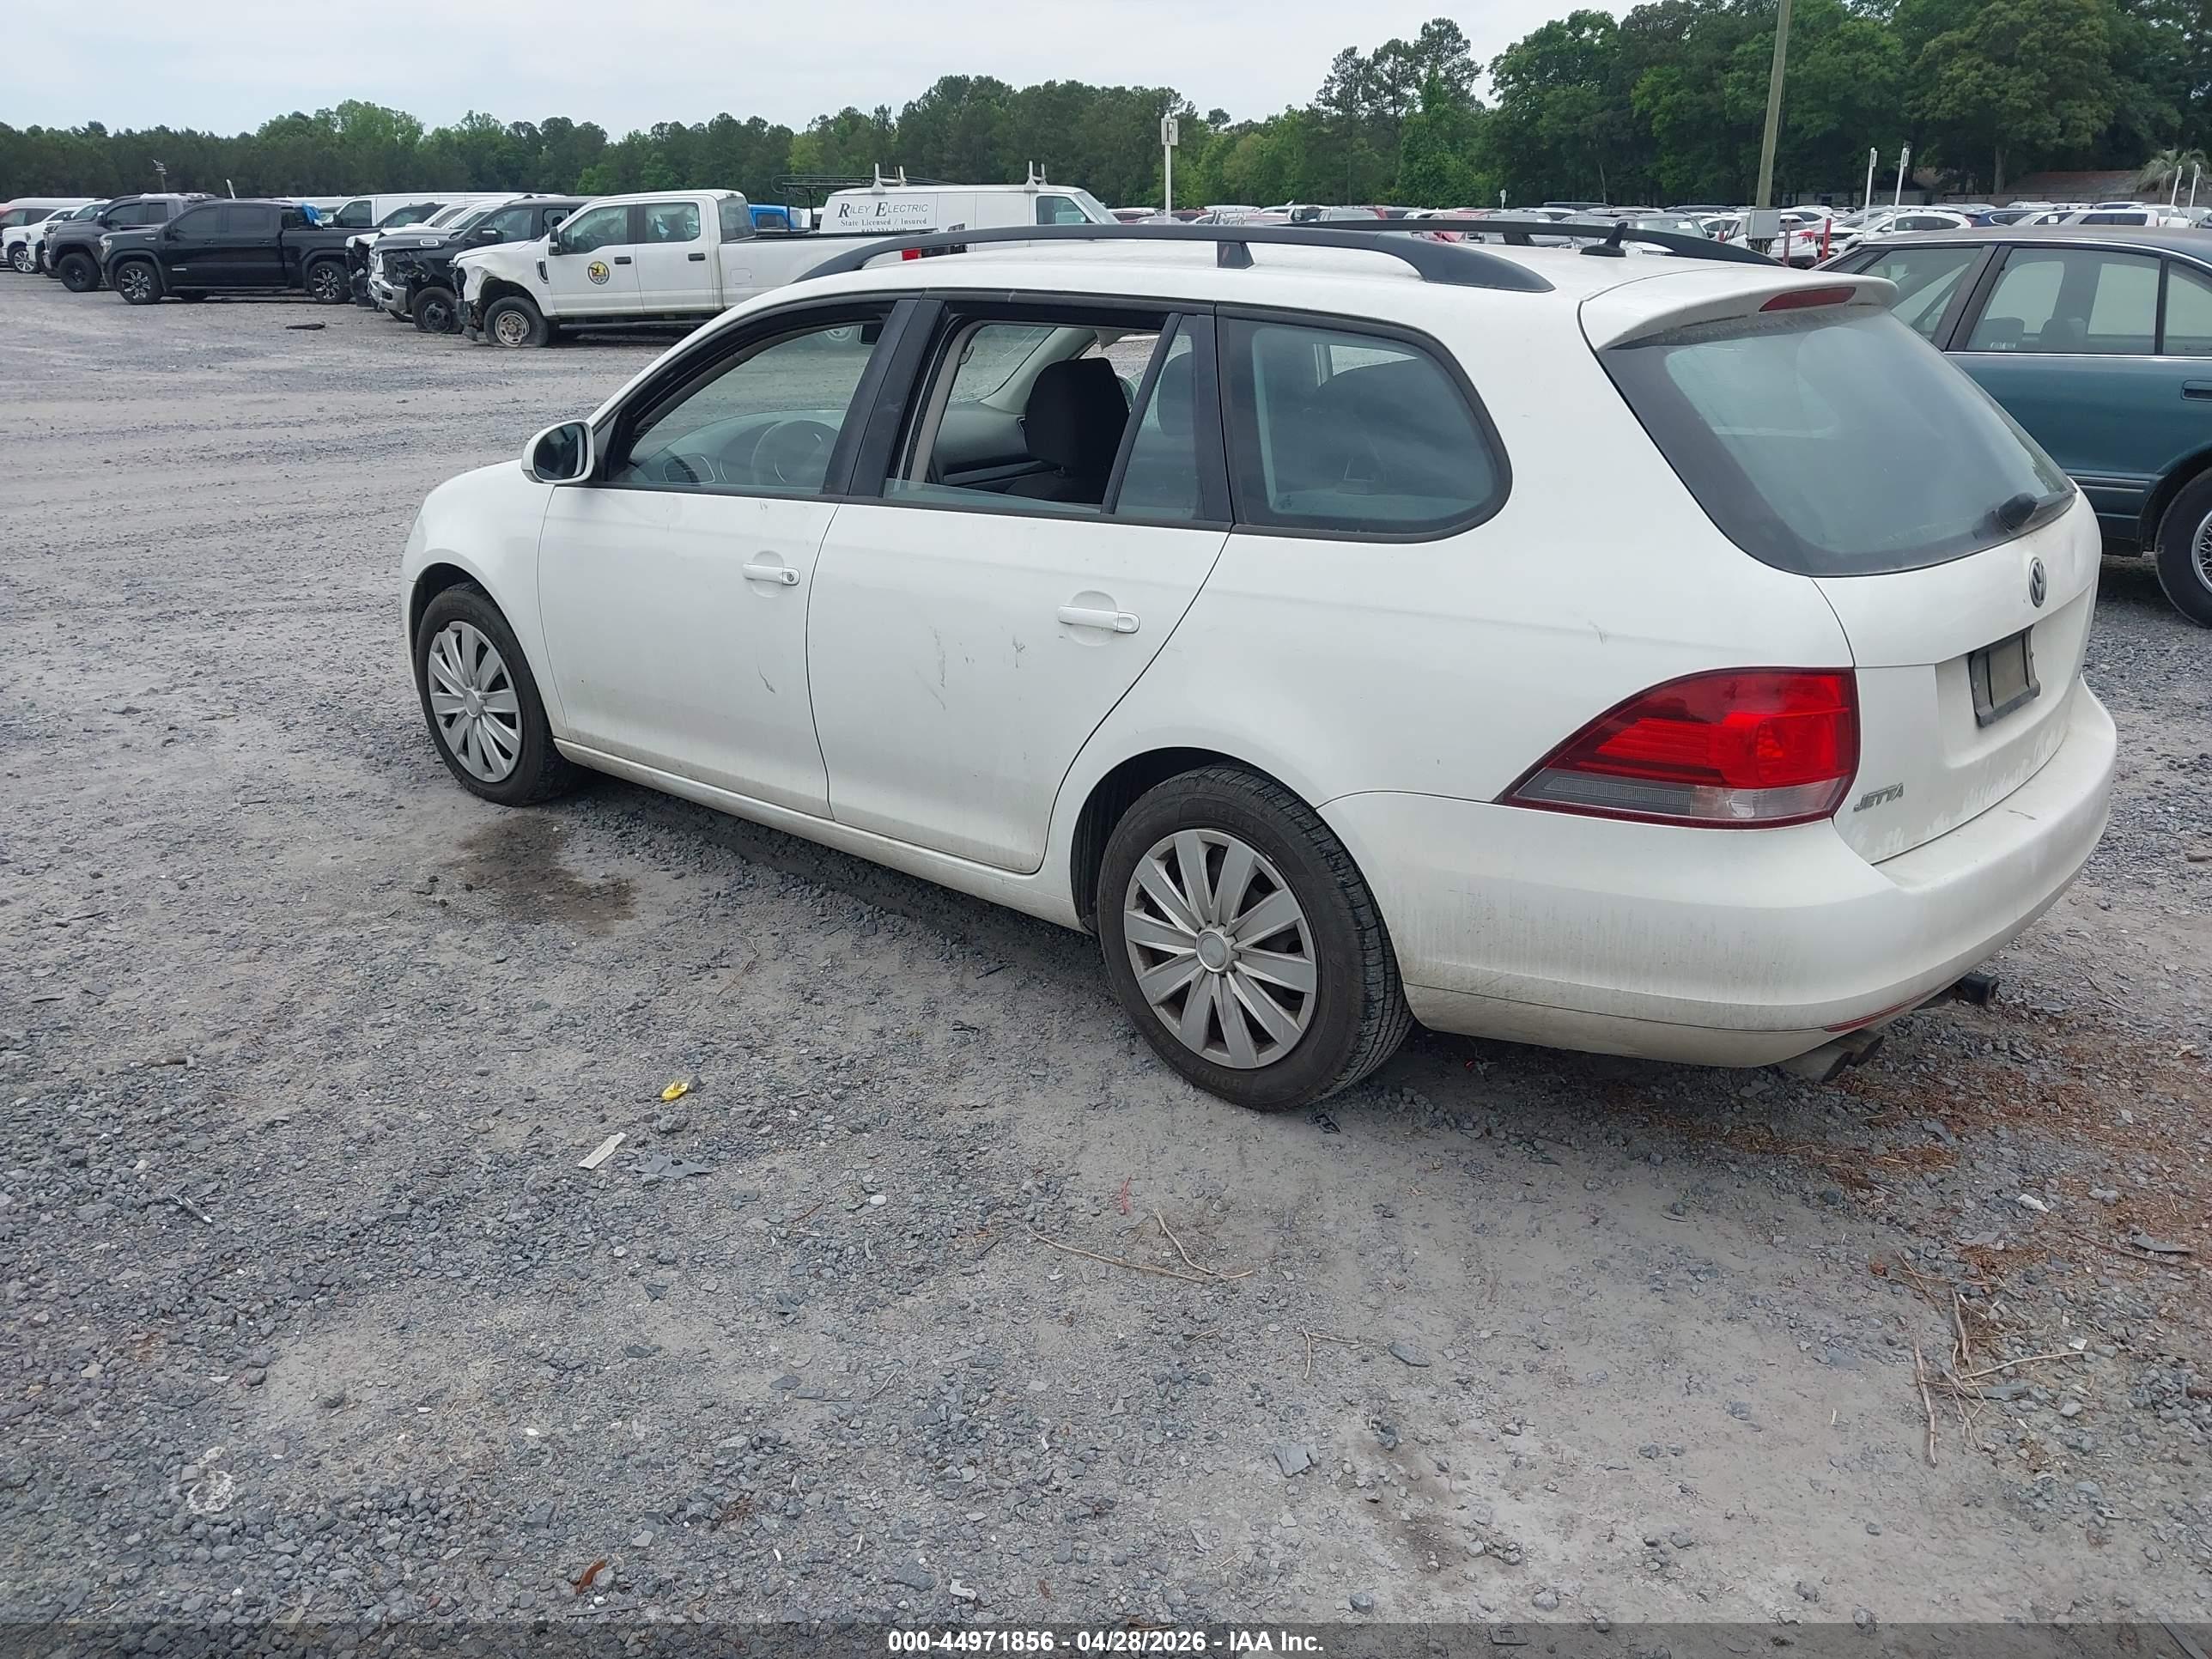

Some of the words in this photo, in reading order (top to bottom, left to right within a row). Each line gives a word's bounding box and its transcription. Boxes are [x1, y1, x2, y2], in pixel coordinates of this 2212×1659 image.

[840, 219, 859, 228] State
[861, 218, 891, 227] Licensed
[901, 217, 927, 226] Insured
[1853, 782, 1904, 812] JETTA
